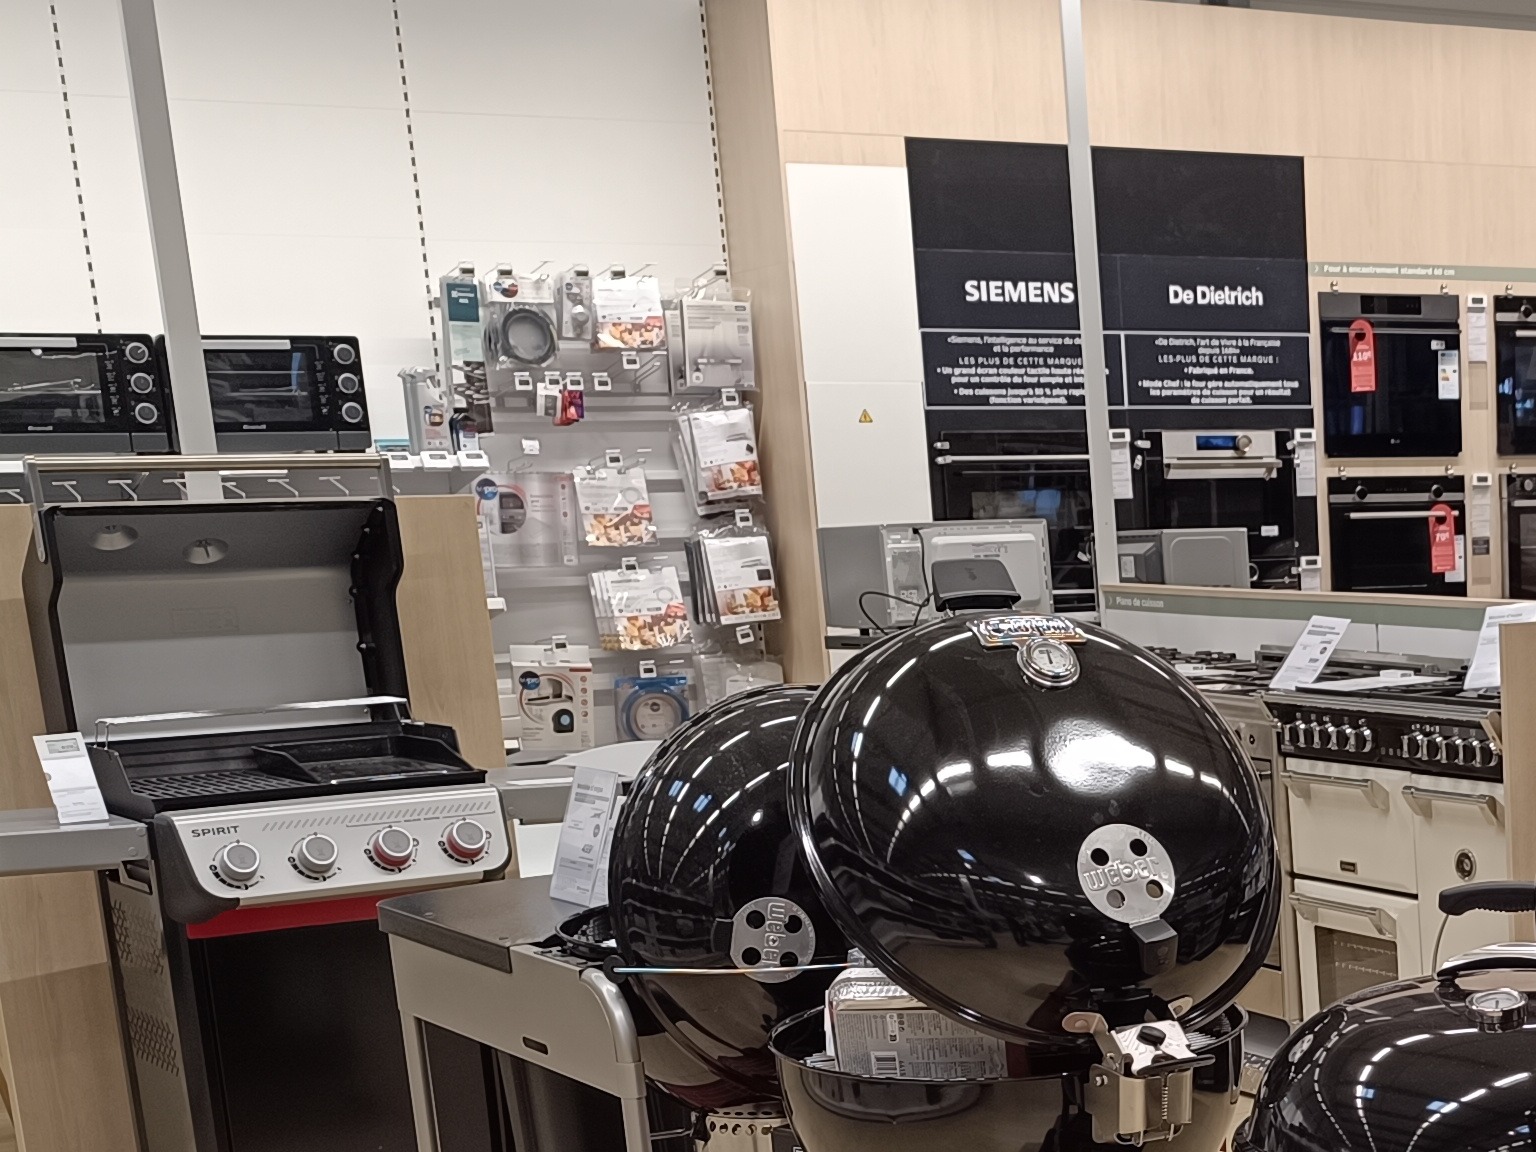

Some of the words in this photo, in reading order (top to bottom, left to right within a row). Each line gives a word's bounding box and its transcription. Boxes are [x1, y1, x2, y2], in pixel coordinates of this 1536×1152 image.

[964, 280, 1075, 304] SIEMENS
[1168, 285, 1194, 305] De
[1198, 285, 1264, 307] Dietrich
[191, 825, 240, 838] SPIRIT
[1083, 857, 1160, 891] weber
